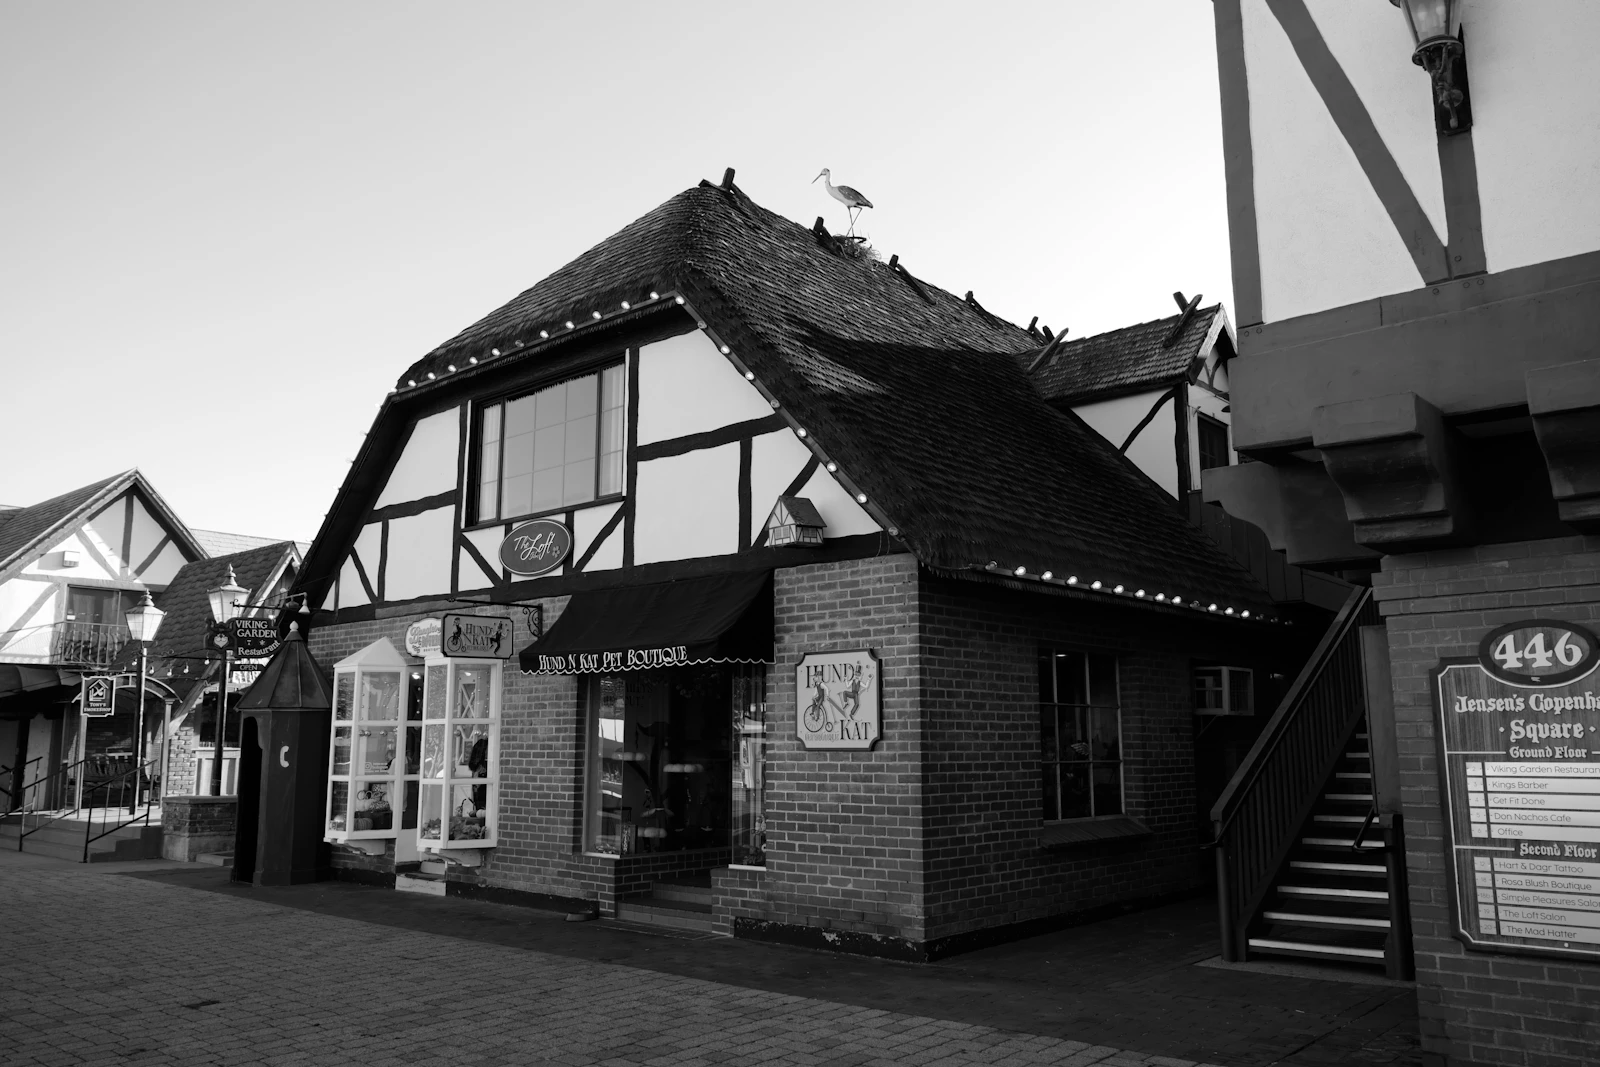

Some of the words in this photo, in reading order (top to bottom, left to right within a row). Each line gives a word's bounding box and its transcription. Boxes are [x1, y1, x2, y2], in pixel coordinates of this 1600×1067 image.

[514, 535, 529, 551] The
[520, 532, 556, 560] Loft
[235, 620, 268, 629] VIKING
[466, 623, 492, 635] HUND
[236, 629, 277, 638] GARDEN
[472, 634, 491, 646] KAT
[238, 640, 281, 656] Restaurant
[1494, 631, 1583, 669] 446
[539, 655, 565, 670] HUND
[568, 653, 577, 669] N
[580, 653, 599, 669] KAT
[603, 651, 622, 667] PET
[627, 645, 687, 665] BOUTIQUE
[805, 663, 855, 688] HUND
[1454, 693, 1526, 713] Jensen's
[840, 719, 871, 740] KAT
[1509, 719, 1585, 743] Square
[1509, 746, 1553, 758] Ground
[1554, 746, 1587, 758] Floor
[1491, 765, 1517, 774] Viking
[1519, 765, 1553, 773] Garden
[1492, 782, 1516, 790] Kings
[1521, 797, 1545, 805] Done
[1514, 813, 1548, 821] Nachos
[1550, 814, 1571, 822] Cafe
[1497, 828, 1523, 836] Office
[1520, 842, 1560, 857] Second
[1564, 844, 1597, 858] Floor
[1499, 861, 1519, 869] Hart
[1520, 862, 1527, 870] &
[1529, 863, 1552, 872] Dagr
[1554, 864, 1584, 873] Tattoo
[1501, 877, 1523, 886] Rosa
[1525, 879, 1549, 887] Blush
[1551, 880, 1592, 891] Boutique
[1501, 893, 1530, 903] Simple
[1532, 895, 1576, 905] Pleasures
[1577, 898, 1600, 908] Salo
[1503, 909, 1519, 918] The
[1521, 911, 1539, 919] Loft
[1540, 912, 1567, 921] Salon
[1506, 925, 1523, 933] The
[1525, 927, 1545, 935] Mad
[1547, 928, 1577, 938] Hatter
